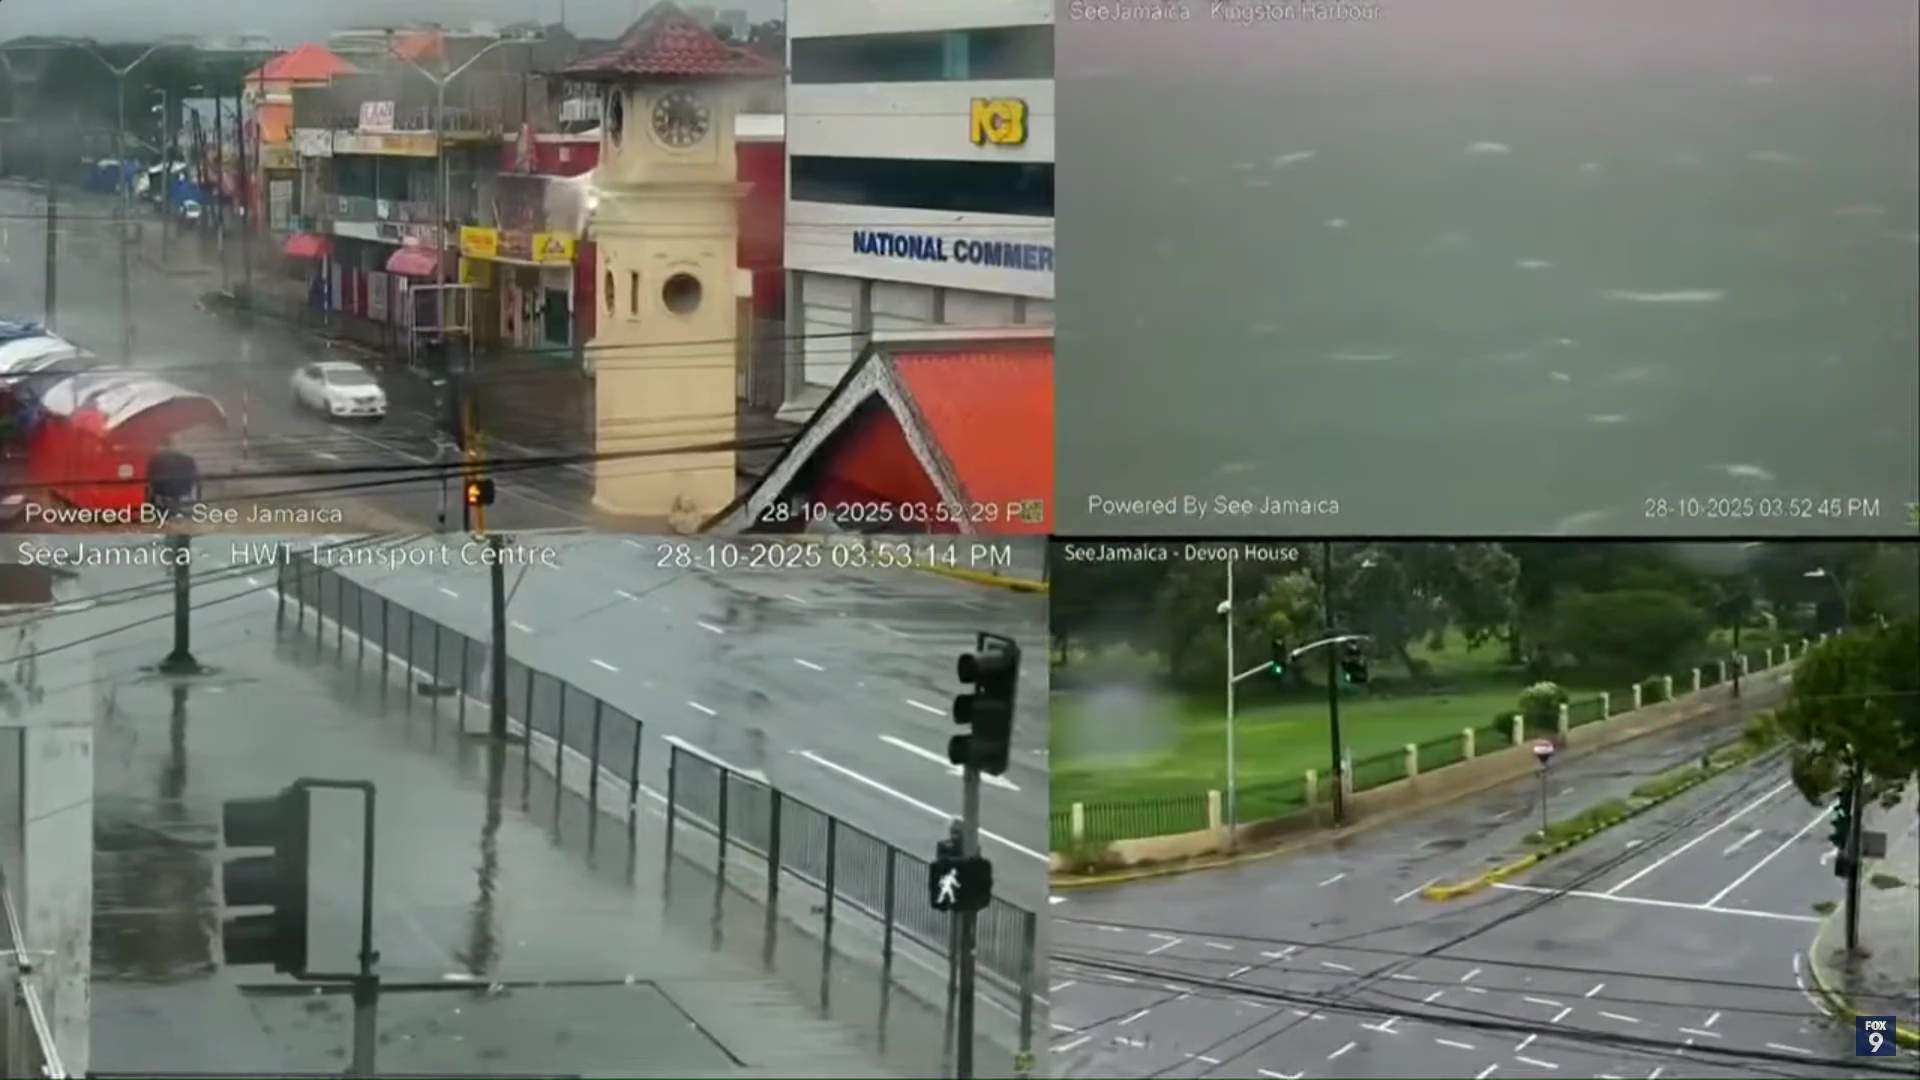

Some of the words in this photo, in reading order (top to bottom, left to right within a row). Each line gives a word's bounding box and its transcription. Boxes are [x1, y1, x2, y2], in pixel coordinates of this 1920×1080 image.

[970, 97, 1028, 145] NCB
[853, 230, 948, 262] NATIONAL
[953, 239, 1055, 271] COMMER
